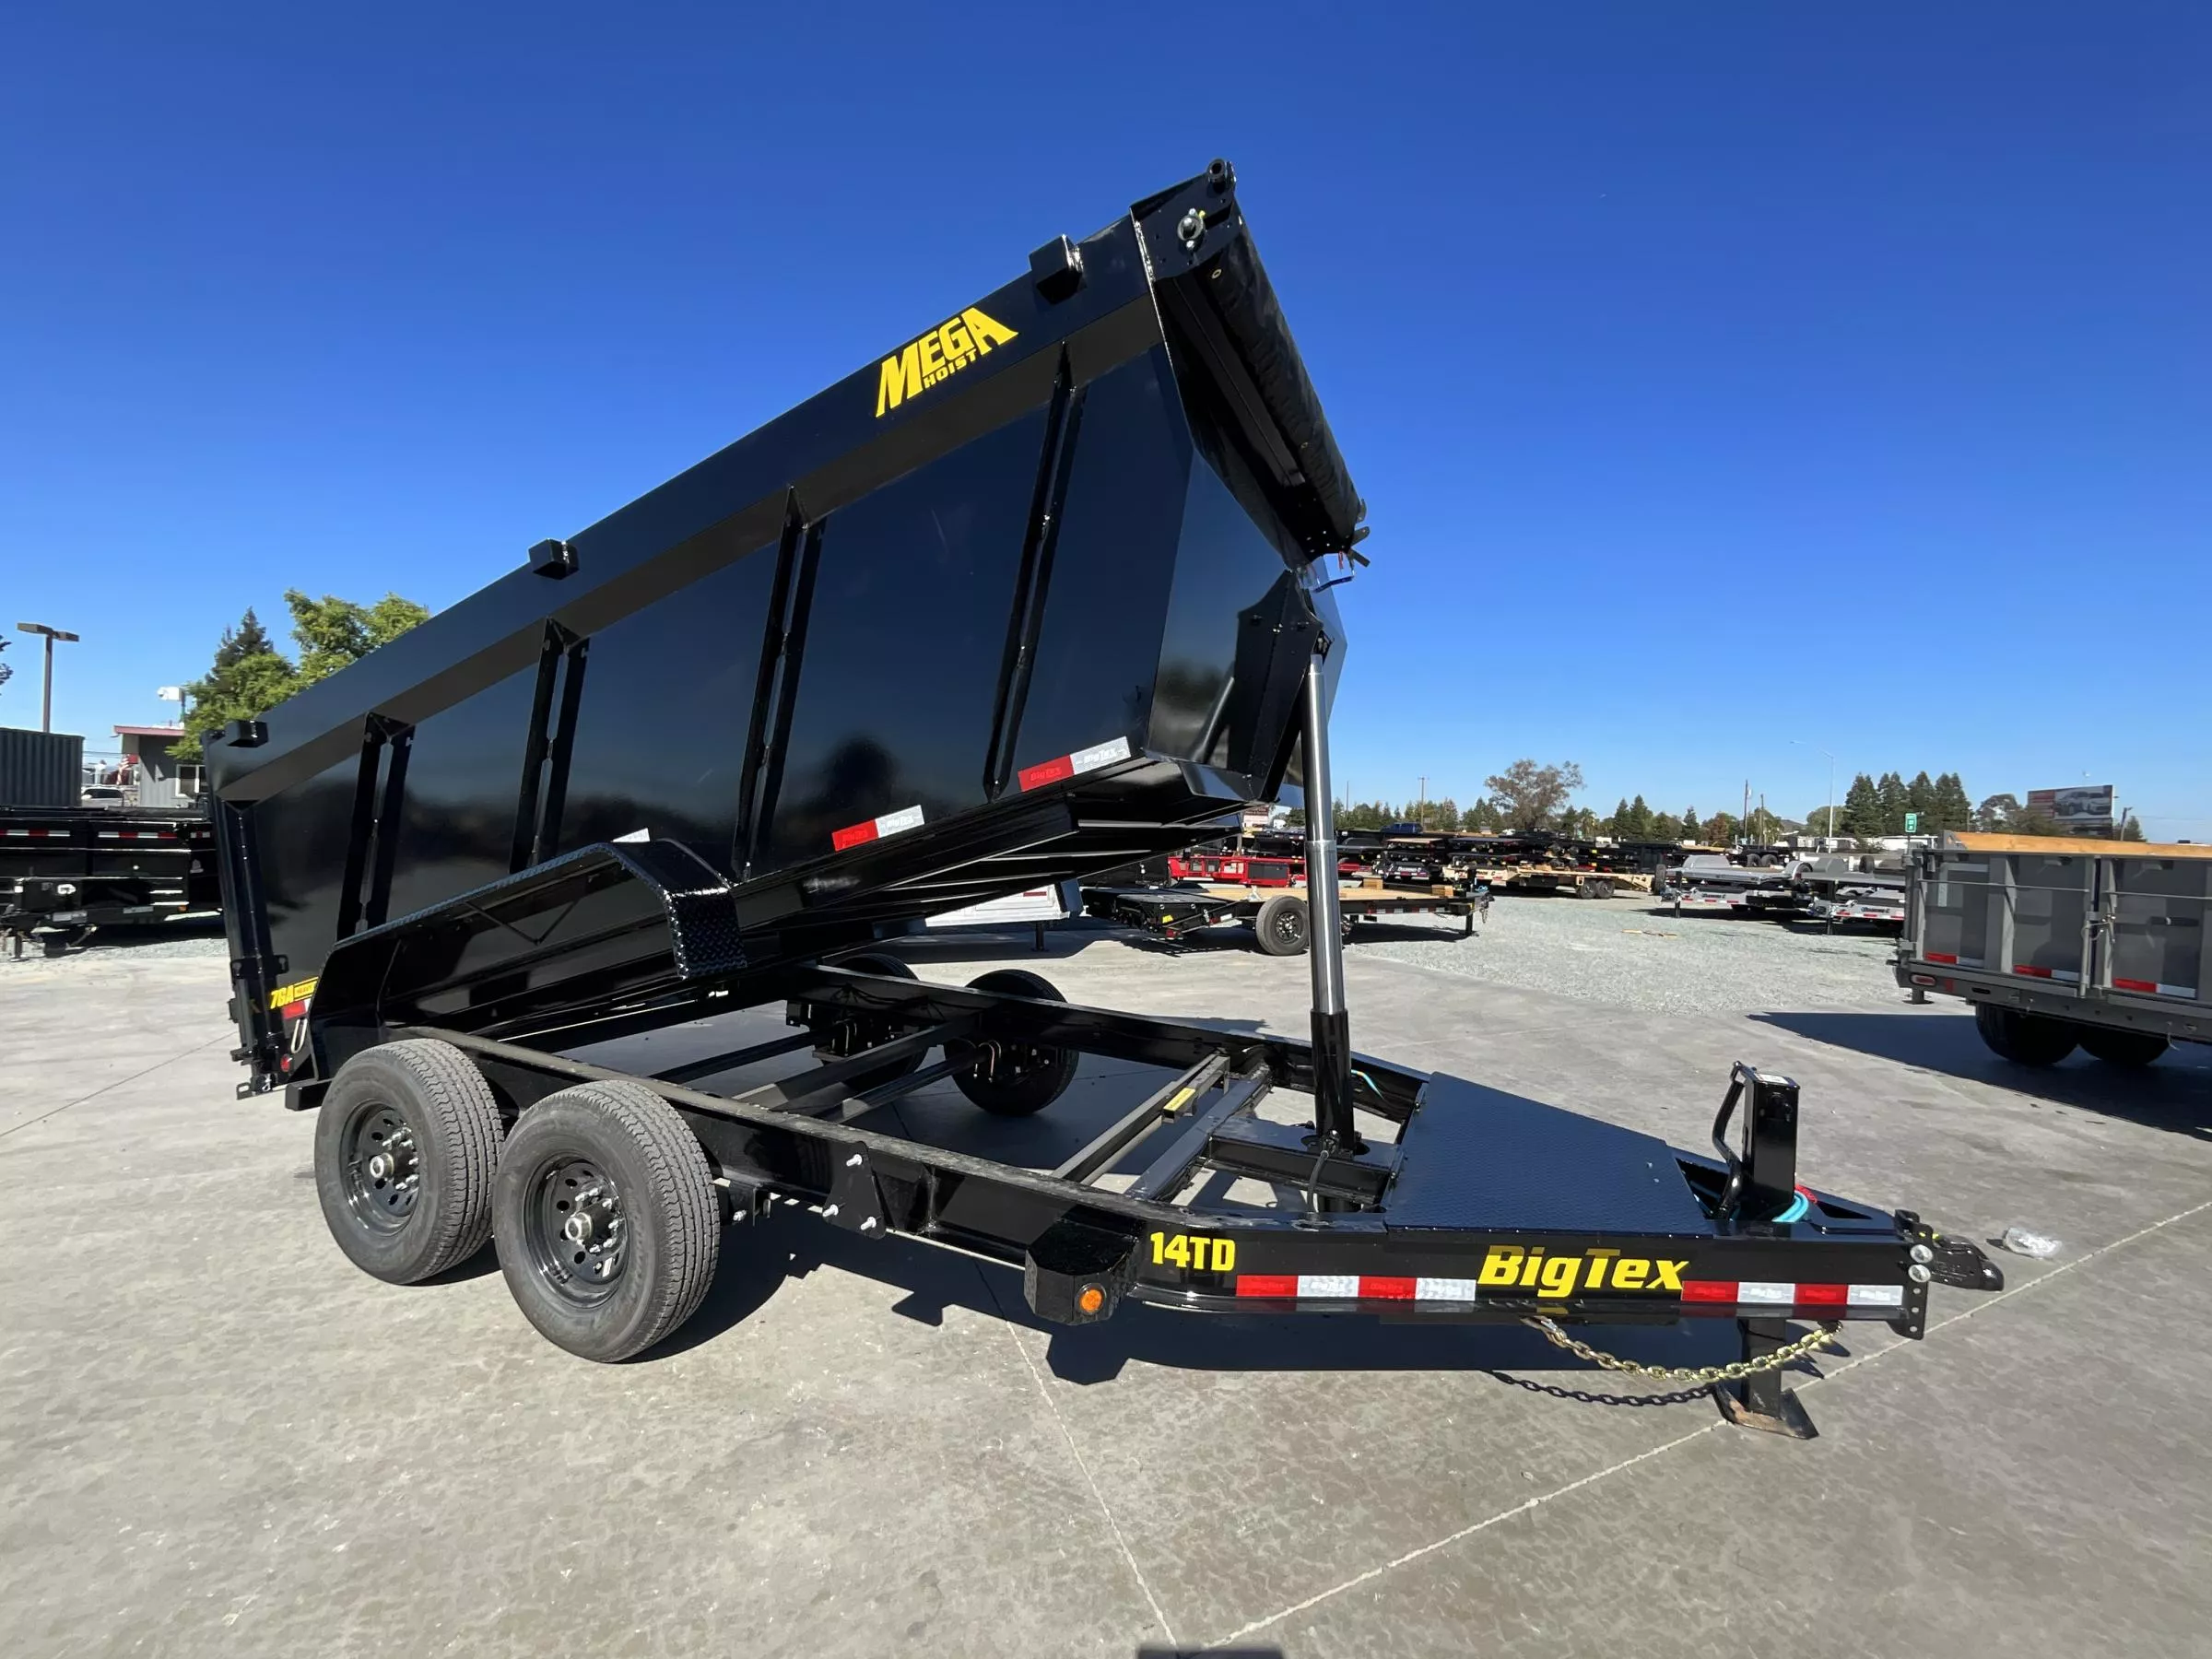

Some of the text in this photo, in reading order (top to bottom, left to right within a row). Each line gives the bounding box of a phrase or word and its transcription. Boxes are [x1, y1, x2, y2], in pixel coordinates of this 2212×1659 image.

[876, 307, 1018, 418] MEGA
[924, 348, 976, 389] HOIST
[1149, 1231, 1236, 1272] 14TD
[1477, 1244, 1688, 1298] BigTex
